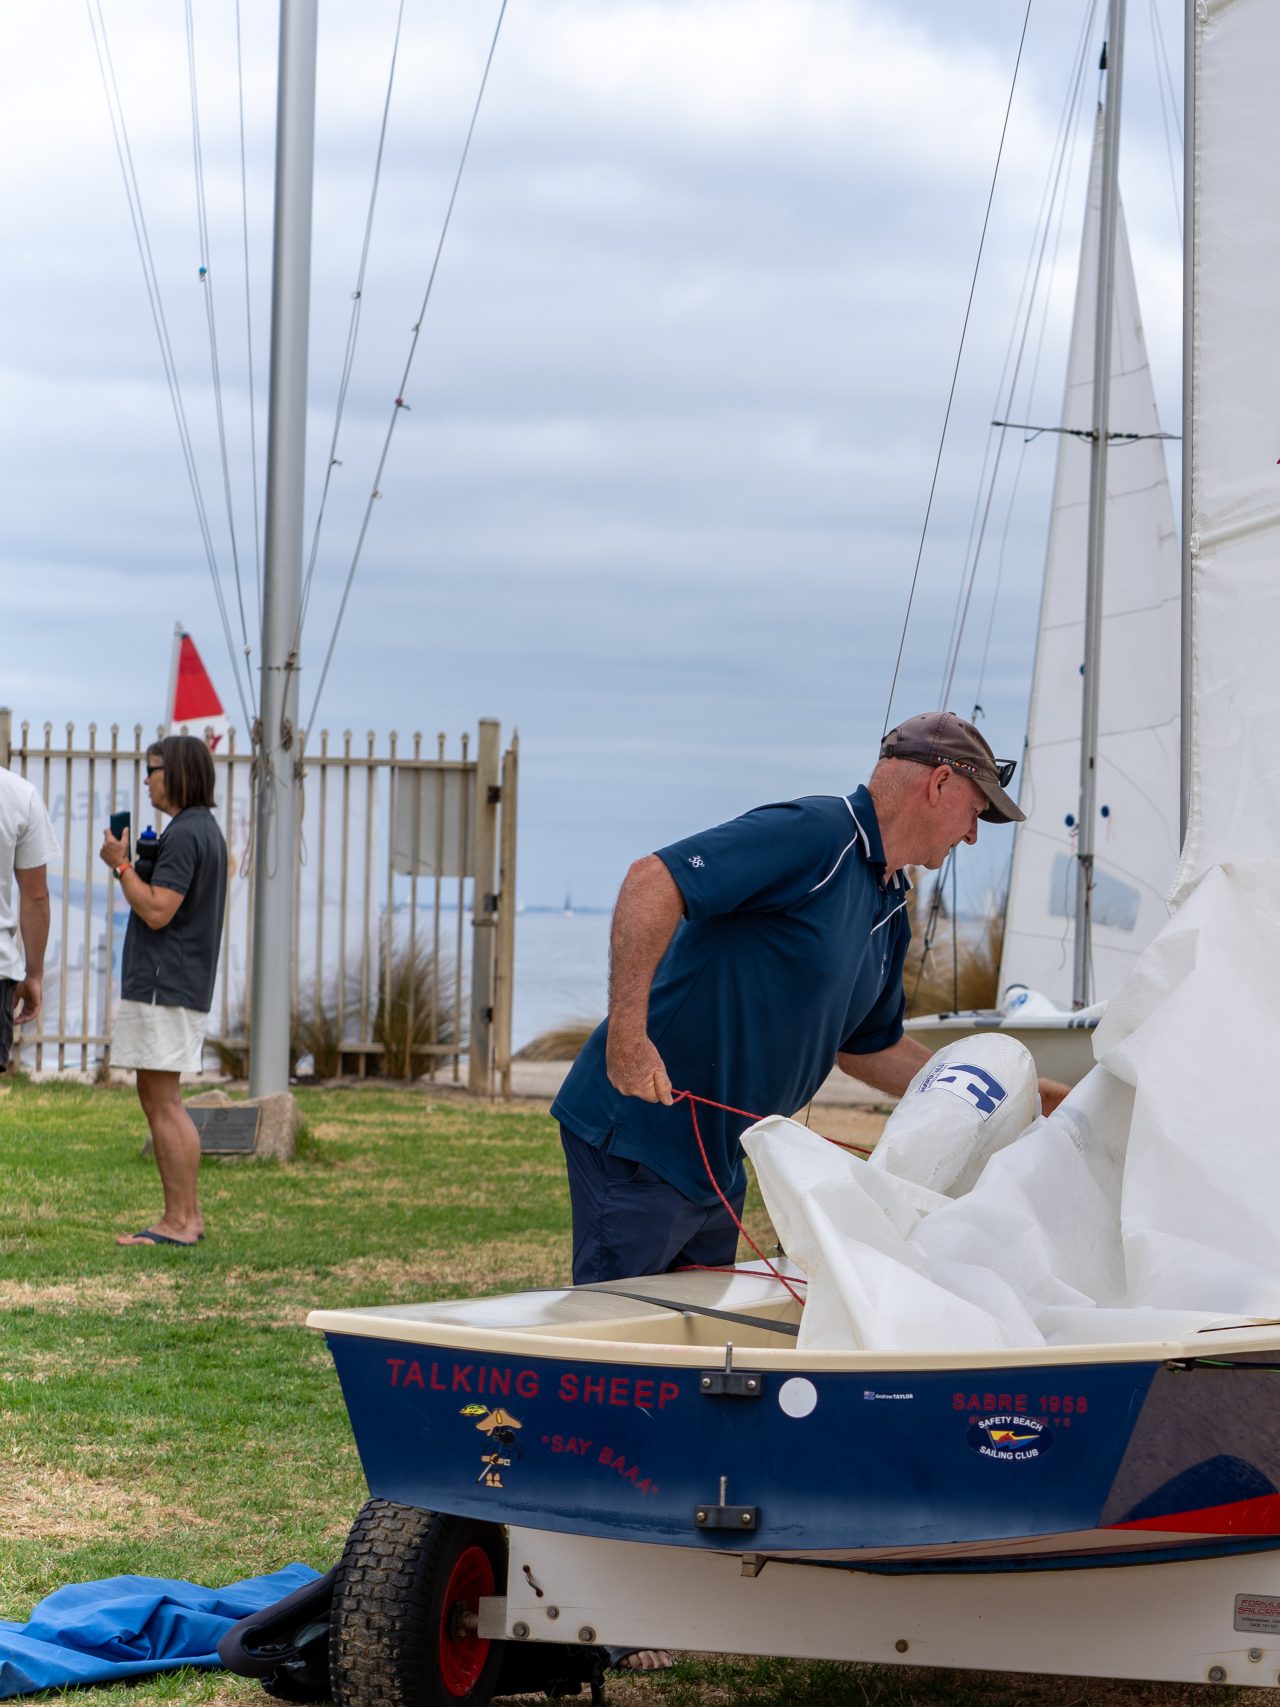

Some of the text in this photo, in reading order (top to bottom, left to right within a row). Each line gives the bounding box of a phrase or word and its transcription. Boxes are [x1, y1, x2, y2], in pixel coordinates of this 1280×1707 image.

[386, 1358, 680, 1409] TALKING SHEEP
[952, 1392, 1088, 1414] SABRE 1958
[978, 1416, 1012, 1429] SAFETY
[1013, 1416, 1043, 1432] BEACH
[979, 1445, 1039, 1460] SAILING CLUB
